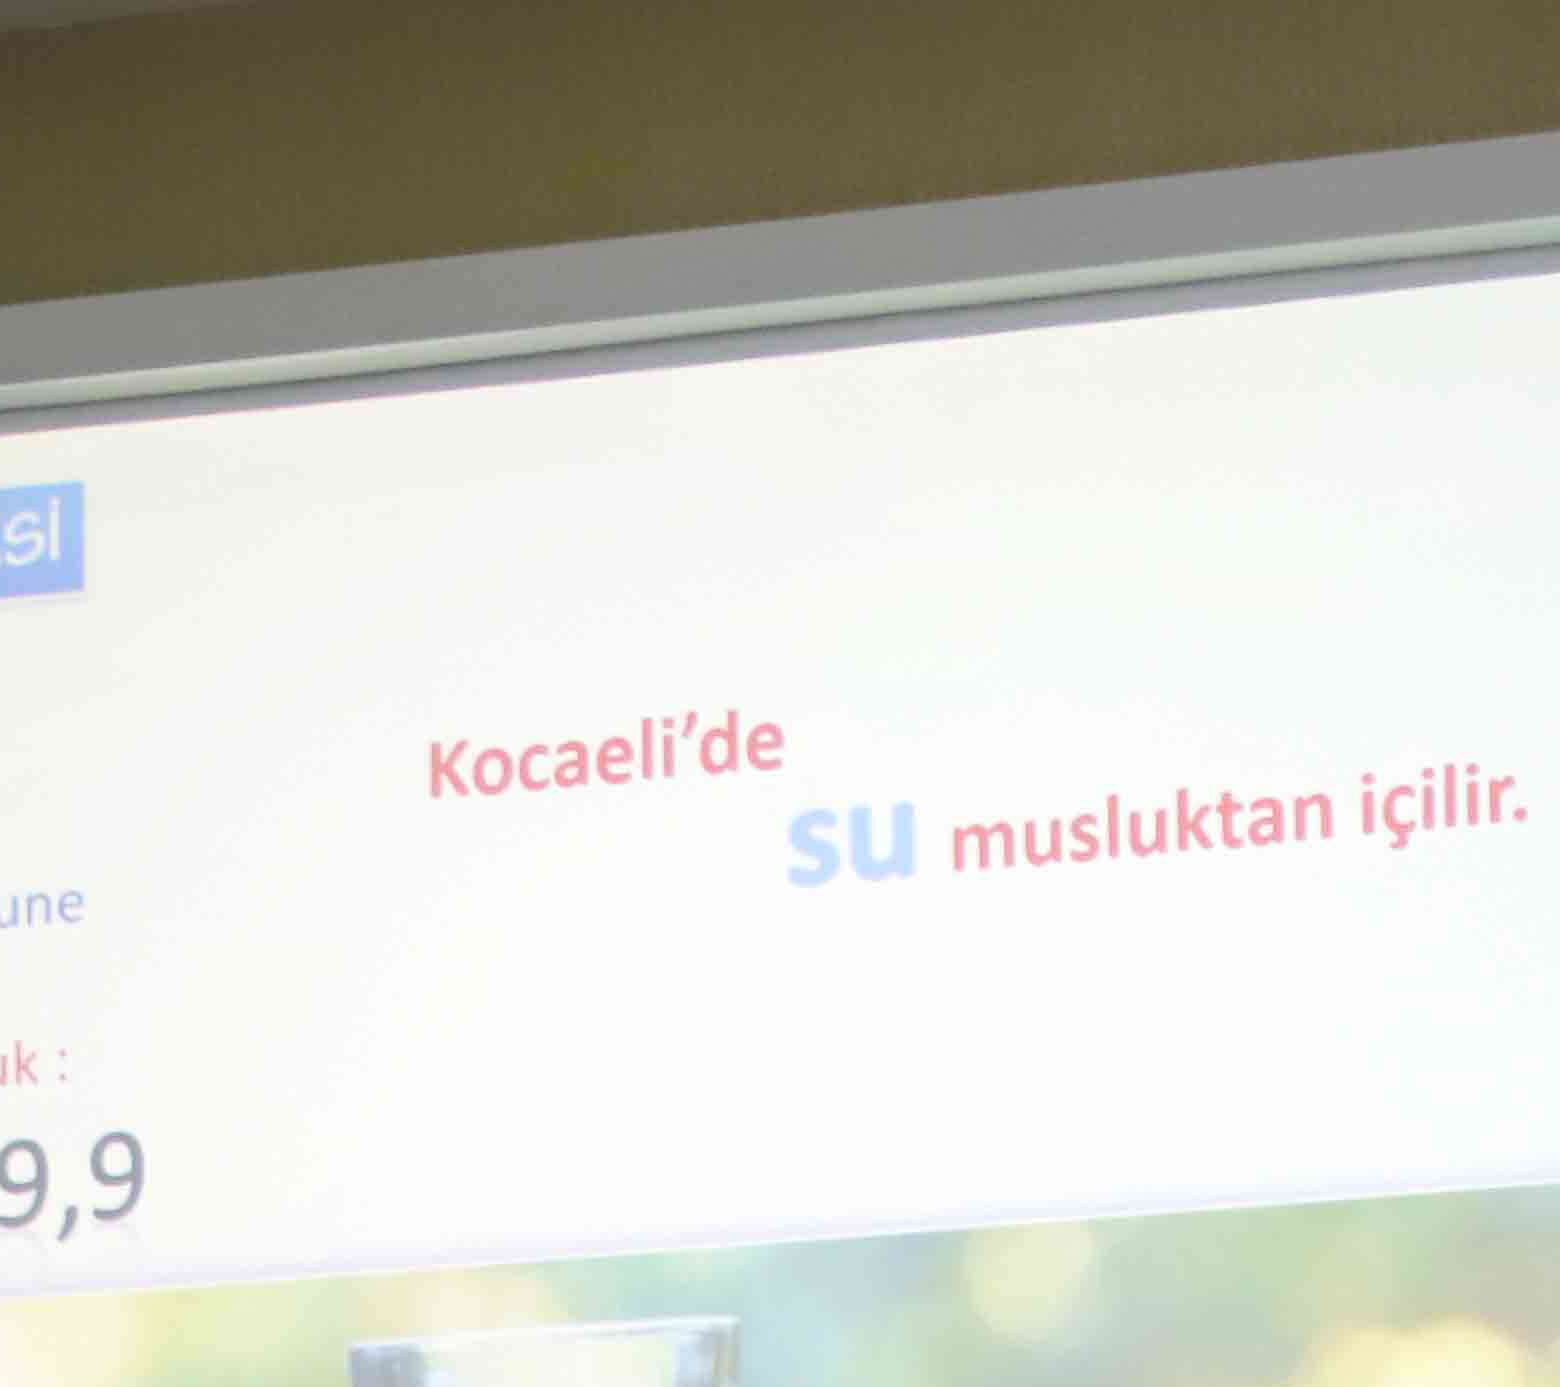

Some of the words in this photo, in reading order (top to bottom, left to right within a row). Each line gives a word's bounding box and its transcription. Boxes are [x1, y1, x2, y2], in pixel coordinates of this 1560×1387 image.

[785, 801, 917, 888] su
[950, 789, 1334, 872] musluktan
[1361, 763, 1530, 850] içilir.
